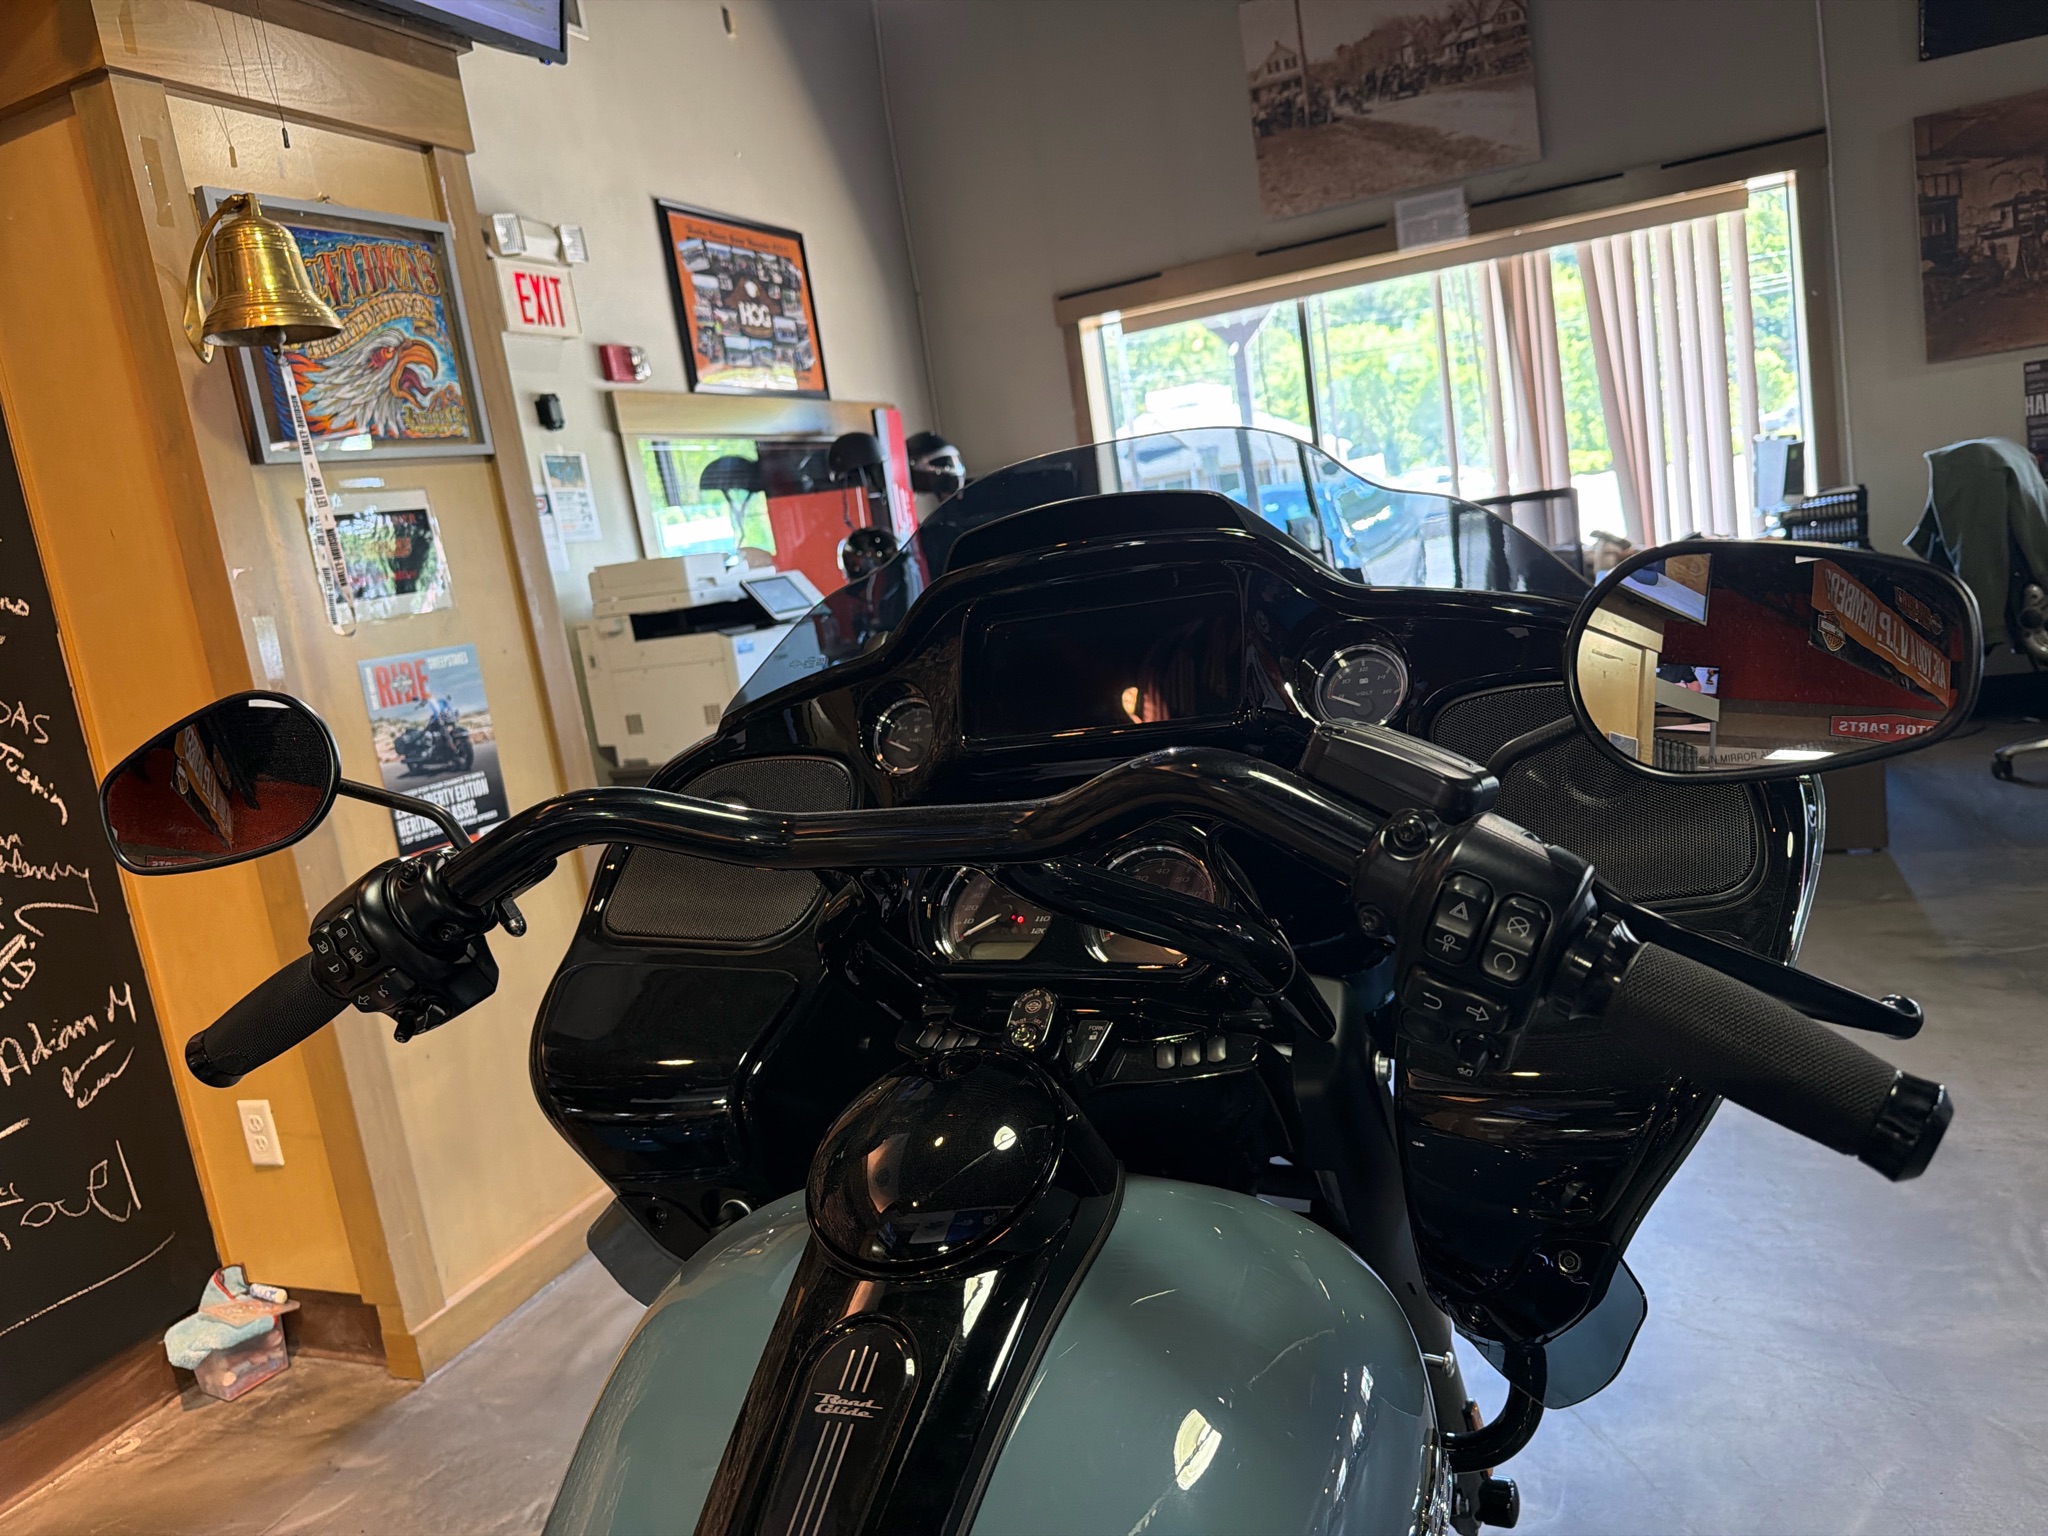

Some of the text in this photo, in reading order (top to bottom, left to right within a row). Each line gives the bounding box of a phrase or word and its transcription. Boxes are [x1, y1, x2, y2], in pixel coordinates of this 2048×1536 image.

[513, 271, 566, 328] EXIT
[2024, 393, 2048, 417] HA
[290, 395, 313, 456] HARLEY-DAVIDSON
[325, 528, 347, 587] HARLEY-DAVIDSON
[373, 659, 431, 708] RIDE
[1720, 750, 1758, 765] MIRROR
[454, 776, 490, 801] EDITION
[396, 812, 442, 840] HERITA
[447, 797, 479, 821] ASSIC
[963, 915, 1051, 926] 10 110
[814, 1392, 884, 1410] Road
[814, 1403, 874, 1419] Glide
